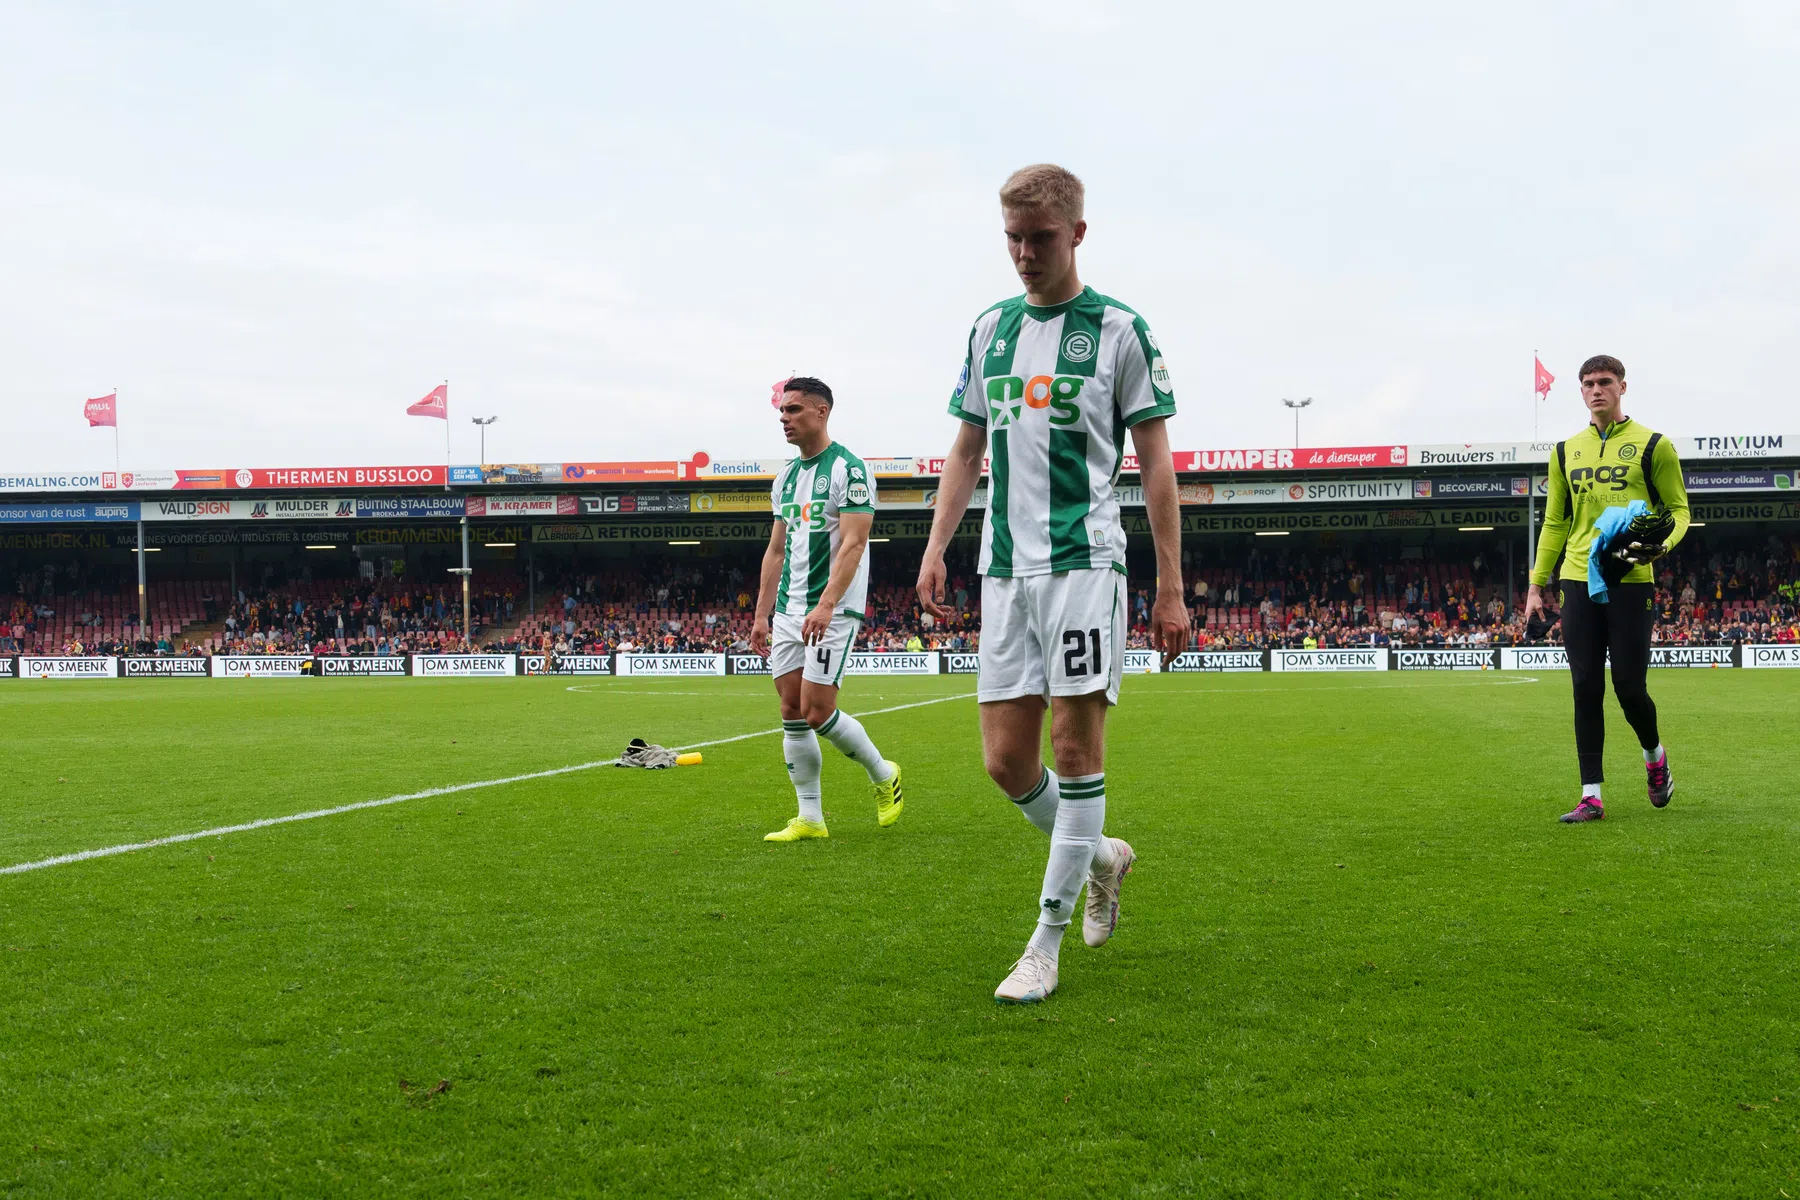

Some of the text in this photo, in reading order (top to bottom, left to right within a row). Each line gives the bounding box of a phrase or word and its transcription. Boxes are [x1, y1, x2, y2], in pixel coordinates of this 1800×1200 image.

[1694, 435, 1783, 450] TRIVIUM
[1187, 450, 1294, 470] JUMPER
[1309, 452, 1324, 464] de
[1326, 451, 1377, 466] diersuper
[1708, 449, 1767, 457] PACKAGING
[885, 462, 909, 471] kleur
[0, 476, 99, 488] BEMALING.COM
[266, 468, 433, 485] THERMEN BUSSLOO
[1688, 476, 1709, 485] Kies
[1734, 475, 1767, 484] elkaar.
[1308, 483, 1403, 498] SPORTUNITY
[1439, 482, 1506, 493] DECOVERF.NL
[357, 498, 465, 510] BUITING STAALBOUW
[490, 501, 553, 510] M. KRAMER
[1600, 494, 1629, 503] FUELS
[30, 509, 48, 518] van
[50, 507, 63, 518] de
[66, 508, 86, 518] rust
[95, 507, 129, 518] auping
[159, 501, 230, 515] VALIDSIGN
[275, 501, 329, 511] MULDER
[1693, 506, 1774, 519] RIDGING
[1197, 514, 1368, 530] RETROBRIDGE.COM
[1387, 518, 1421, 527] BRIDGE
[1440, 510, 1520, 525] LEADING
[117, 535, 166, 544] MACINES
[167, 534, 193, 544] VOOR
[195, 534, 208, 543] DE
[242, 532, 291, 543] INDUSTRIE
[292, 532, 300, 541] &
[301, 531, 349, 542] LOGISTIEK
[550, 532, 580, 540] BRIDGE
[598, 525, 756, 539] RETROBRIDGE.COM
[1062, 628, 1102, 677] 21
[1277, 652, 1376, 666] TOM SMEENK
[1392, 650, 1494, 666] TOM SMEENK
[1511, 650, 1548, 665] TOM
[1669, 650, 1732, 662] SMEENK
[1748, 647, 1786, 662] TOM
[24, 659, 55, 673] TOM
[58, 661, 108, 672] SMEENK
[121, 658, 206, 673] TOM SMEENK
[220, 658, 251, 671] TOM
[317, 657, 405, 672] TOM SMEENK
[418, 657, 505, 671] TOM SMEENK
[560, 658, 610, 670] MEENK
[625, 656, 716, 670] TOM SMEENK
[728, 655, 763, 670] TOM
[816, 648, 831, 675] 4
[847, 656, 928, 669] OM SMEENK
[943, 654, 978, 669] TOM
[1203, 654, 1262, 667] SMEENK
